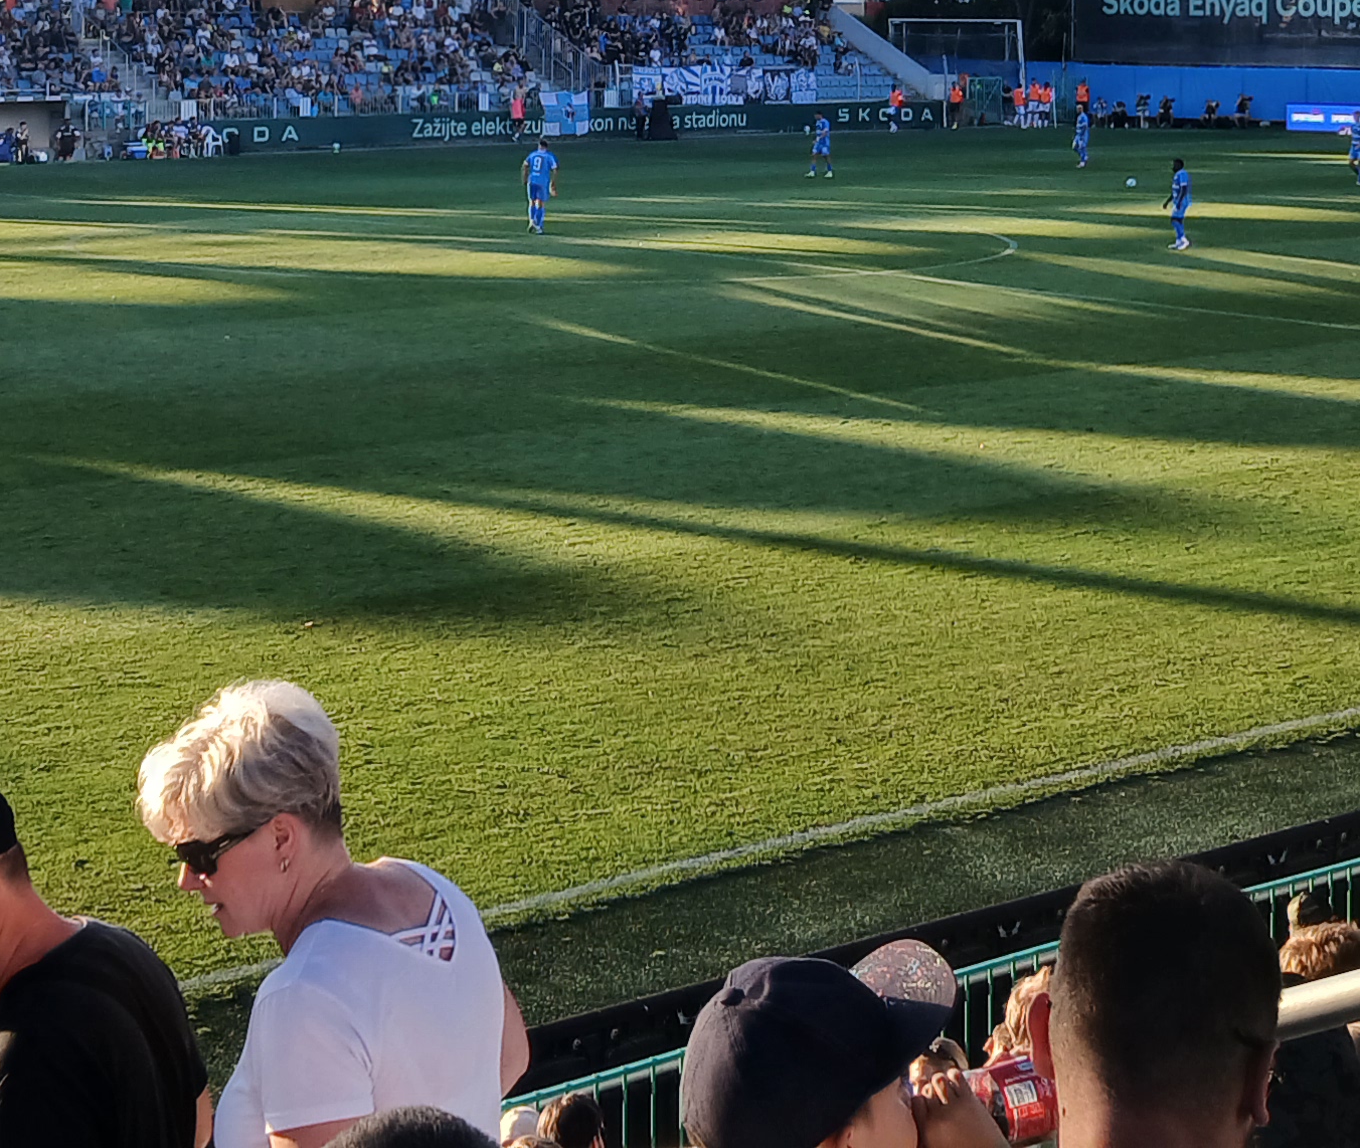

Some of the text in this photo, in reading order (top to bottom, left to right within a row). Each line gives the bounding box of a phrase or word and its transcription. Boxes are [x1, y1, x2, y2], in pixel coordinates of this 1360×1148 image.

[411, 117, 467, 142] Zažijte
[684, 108, 747, 129] stadionu
[532, 156, 543, 172] 9
